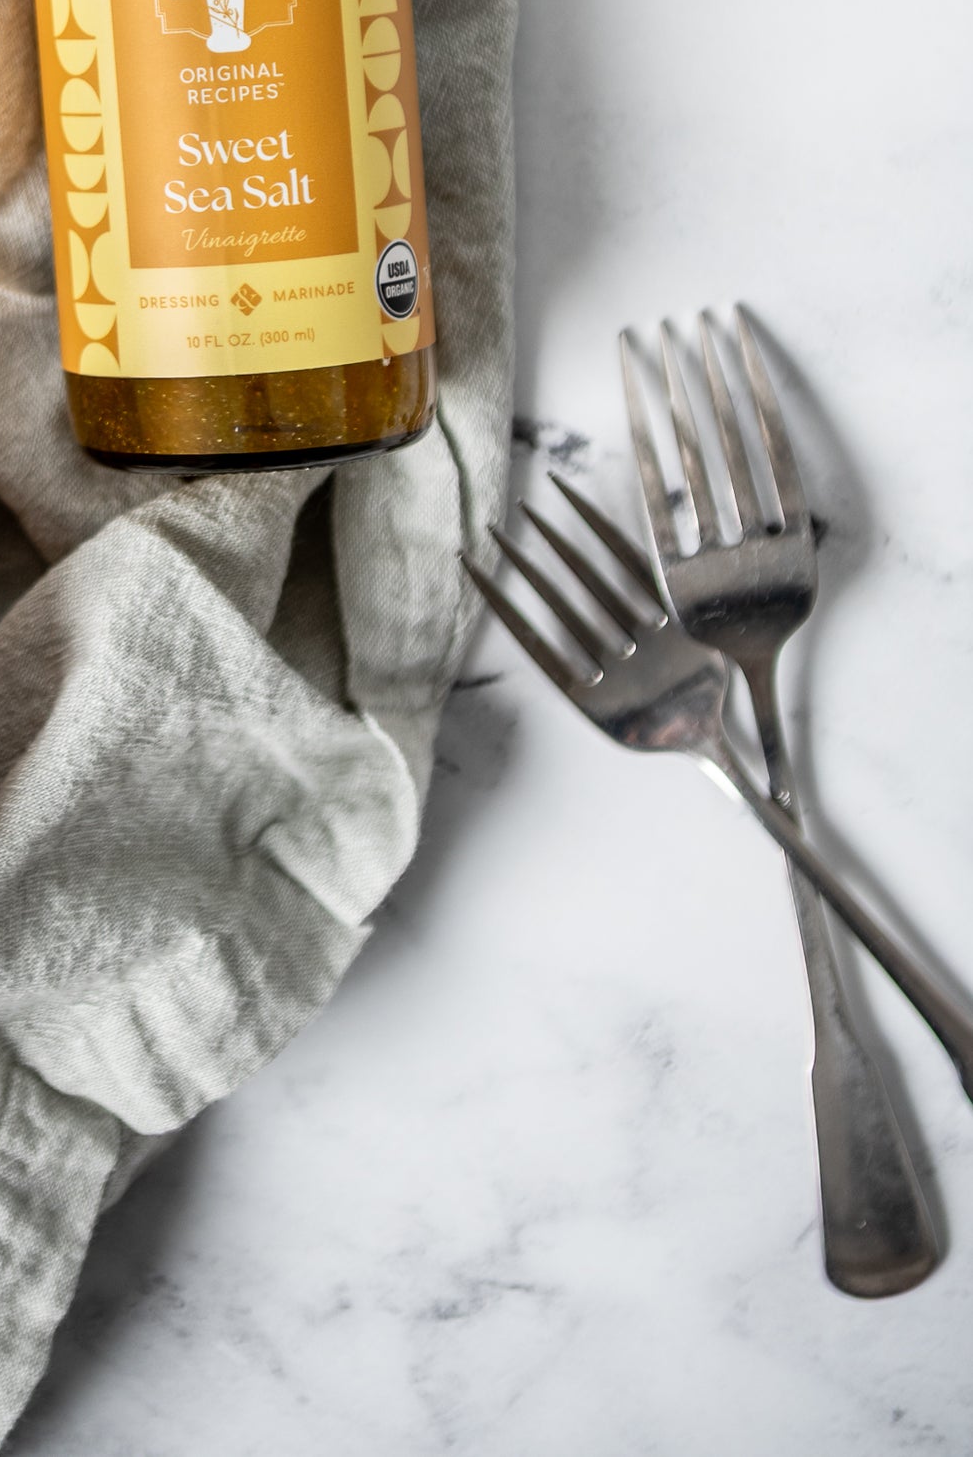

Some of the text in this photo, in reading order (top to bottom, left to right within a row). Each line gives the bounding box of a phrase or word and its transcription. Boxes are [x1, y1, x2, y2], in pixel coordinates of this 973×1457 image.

[179, 61, 284, 84] ORIGINAL
[178, 128, 296, 167] Sweet
[163, 167, 317, 214] Sea Salt
[180, 225, 308, 258] Vinaigrette
[387, 259, 411, 279] USDA
[139, 294, 220, 310] DRESSING
[272, 281, 356, 303] MARINADE
[385, 280, 415, 299] ORGANIC
[186, 327, 316, 349] 10 FL OZ. (300 ml)
